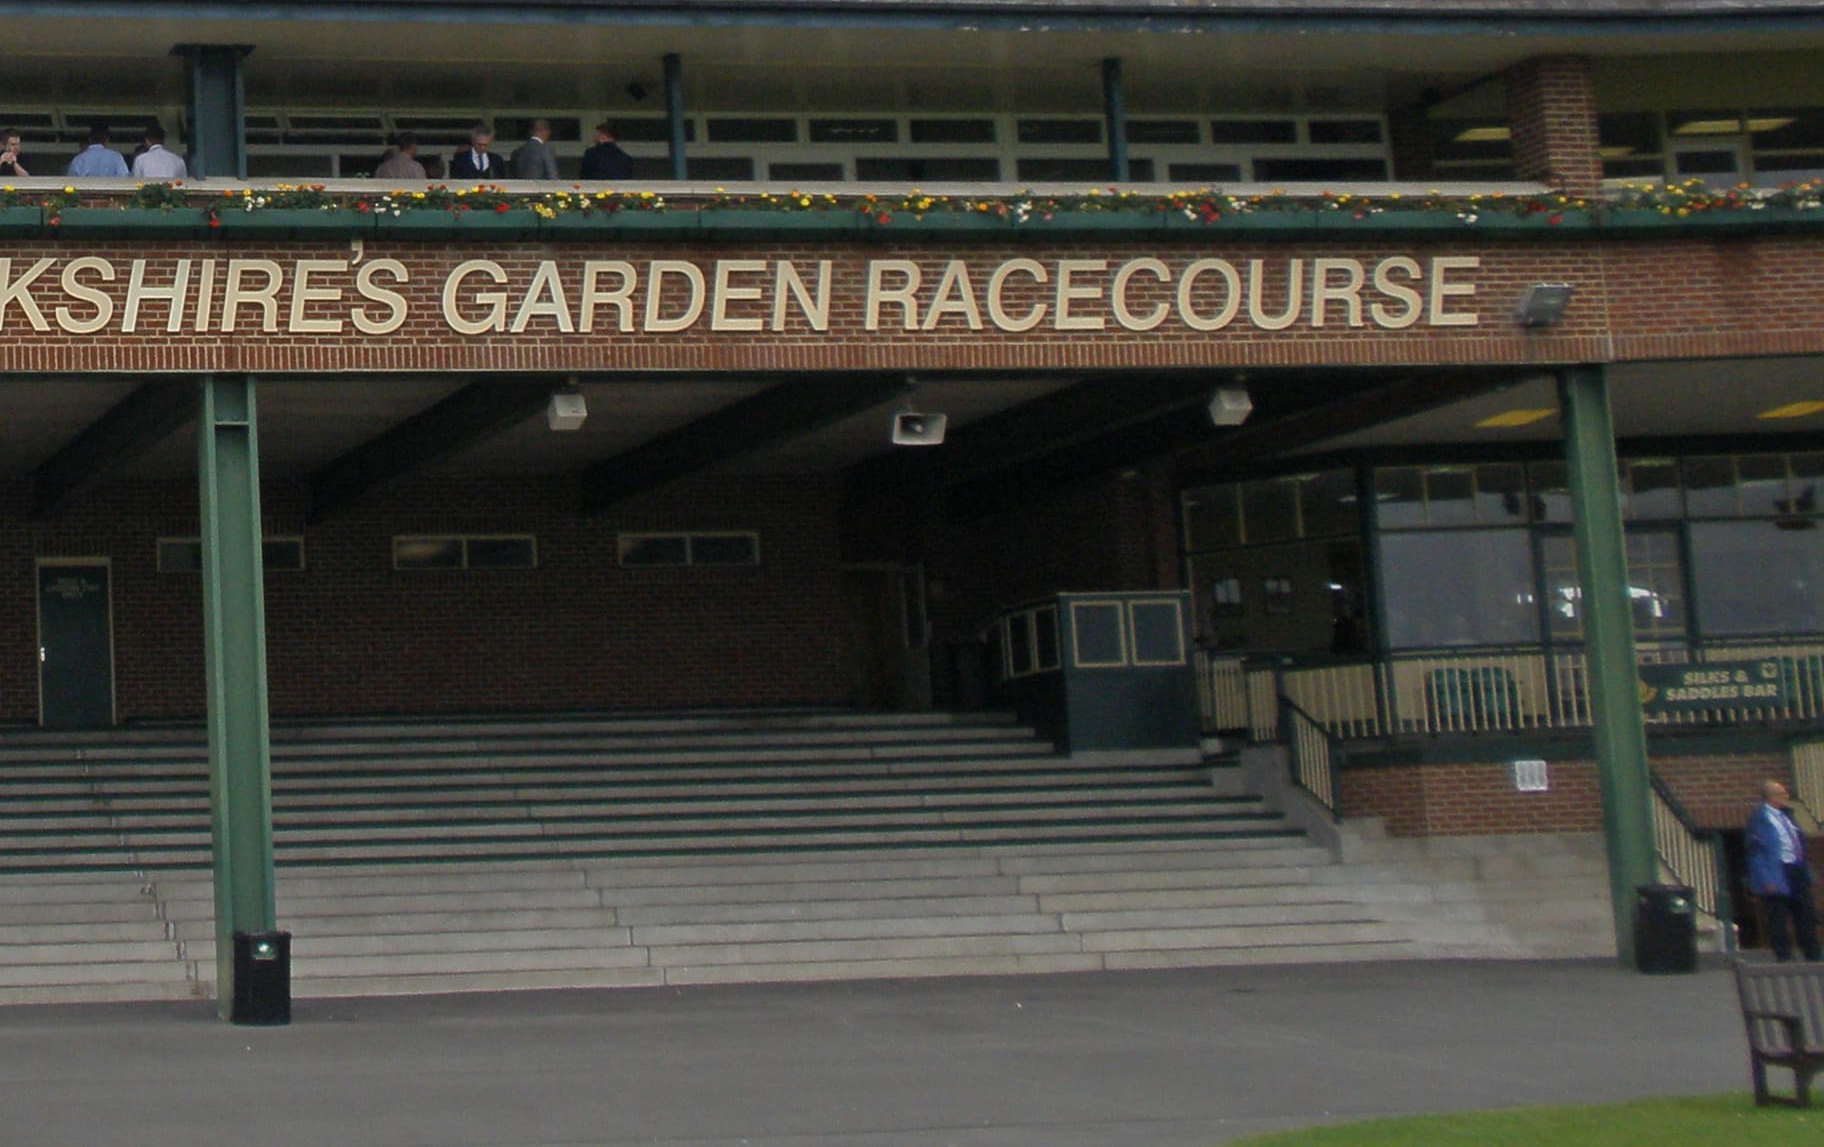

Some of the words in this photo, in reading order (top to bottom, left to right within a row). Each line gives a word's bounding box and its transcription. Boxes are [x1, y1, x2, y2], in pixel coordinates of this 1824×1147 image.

[441, 259, 833, 335] GARDEN
[864, 256, 1480, 332] RACECOURSE
[1683, 671, 1730, 685] SILKS
[1734, 670, 1748, 683] &
[1666, 686, 1739, 702] SADDLES
[1743, 684, 1777, 697] BAR
